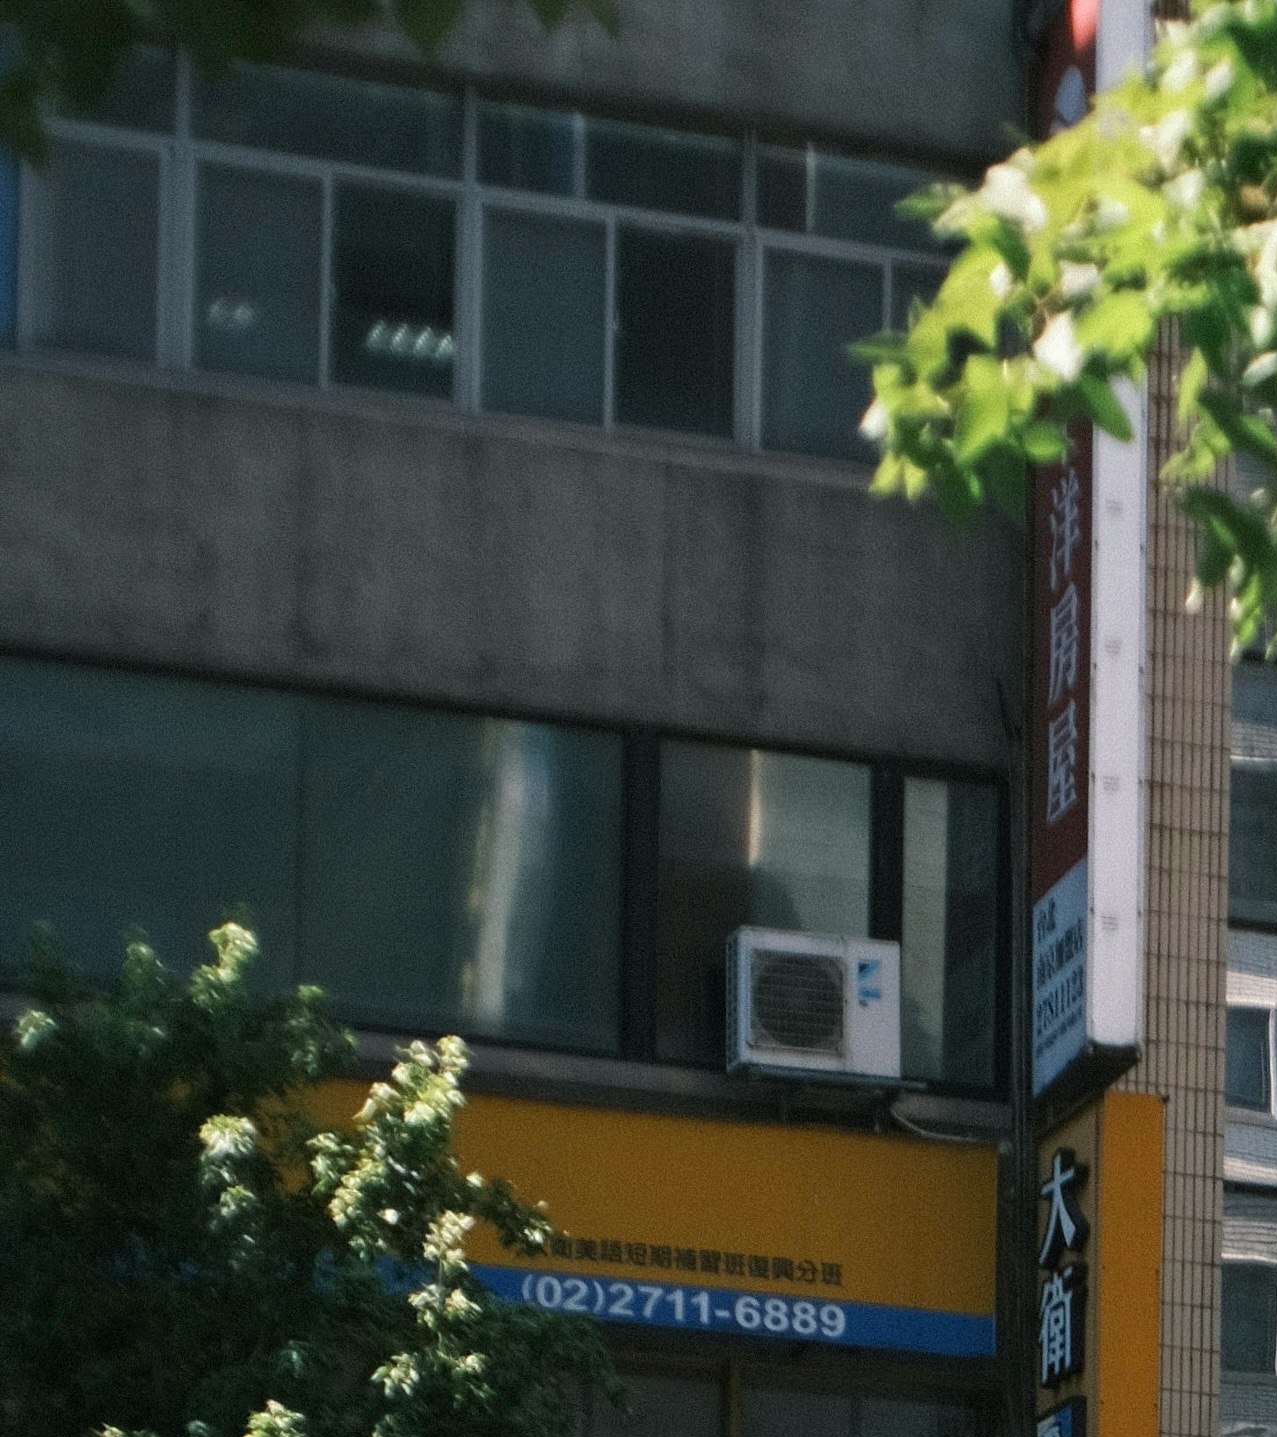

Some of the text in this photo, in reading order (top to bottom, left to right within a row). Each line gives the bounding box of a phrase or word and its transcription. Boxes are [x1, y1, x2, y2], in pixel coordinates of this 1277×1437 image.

[1046, 432, 1081, 828] 洋房屋
[521, 1273, 847, 1339] (02)2711-6889
[1037, 1151, 1079, 1384] 大衛
